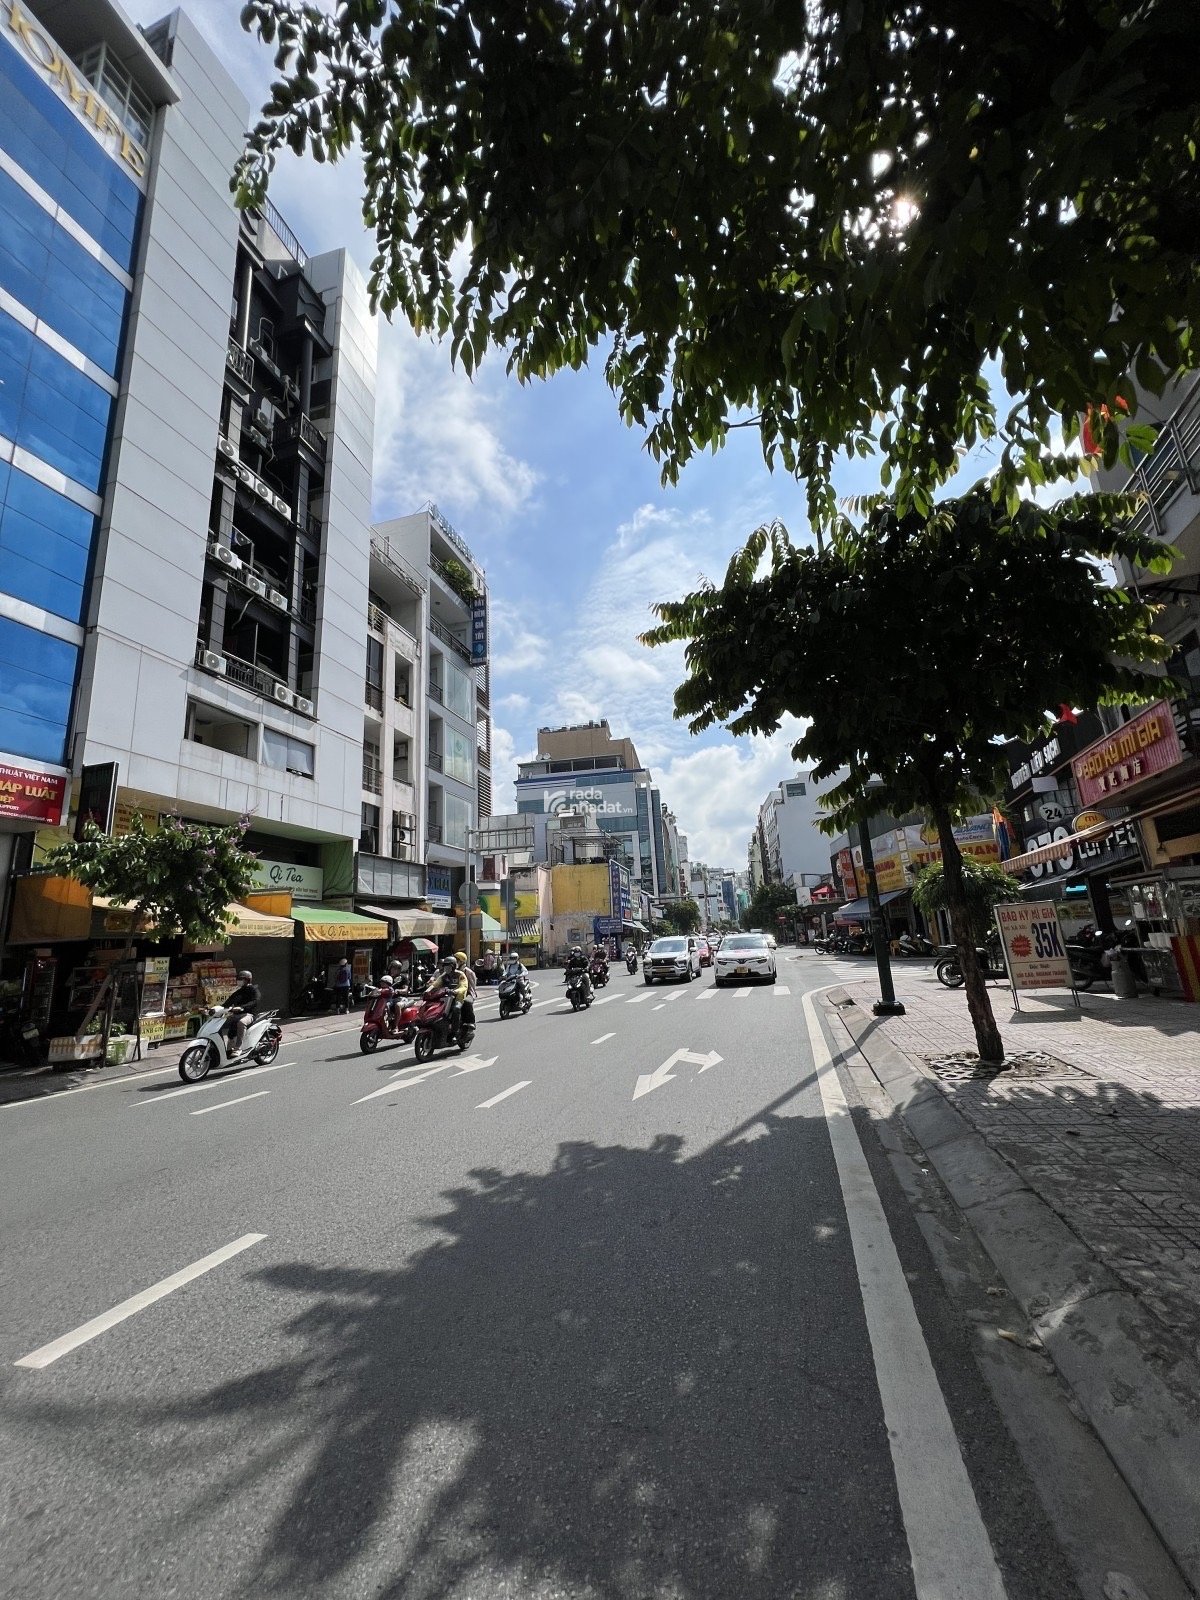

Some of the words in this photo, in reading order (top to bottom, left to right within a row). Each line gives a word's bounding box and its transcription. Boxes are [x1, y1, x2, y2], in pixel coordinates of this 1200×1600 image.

[25, 784, 58, 801] LUẬT
[269, 865, 283, 884] Qi
[286, 867, 304, 883] Tea
[1031, 921, 1064, 958] 35K
